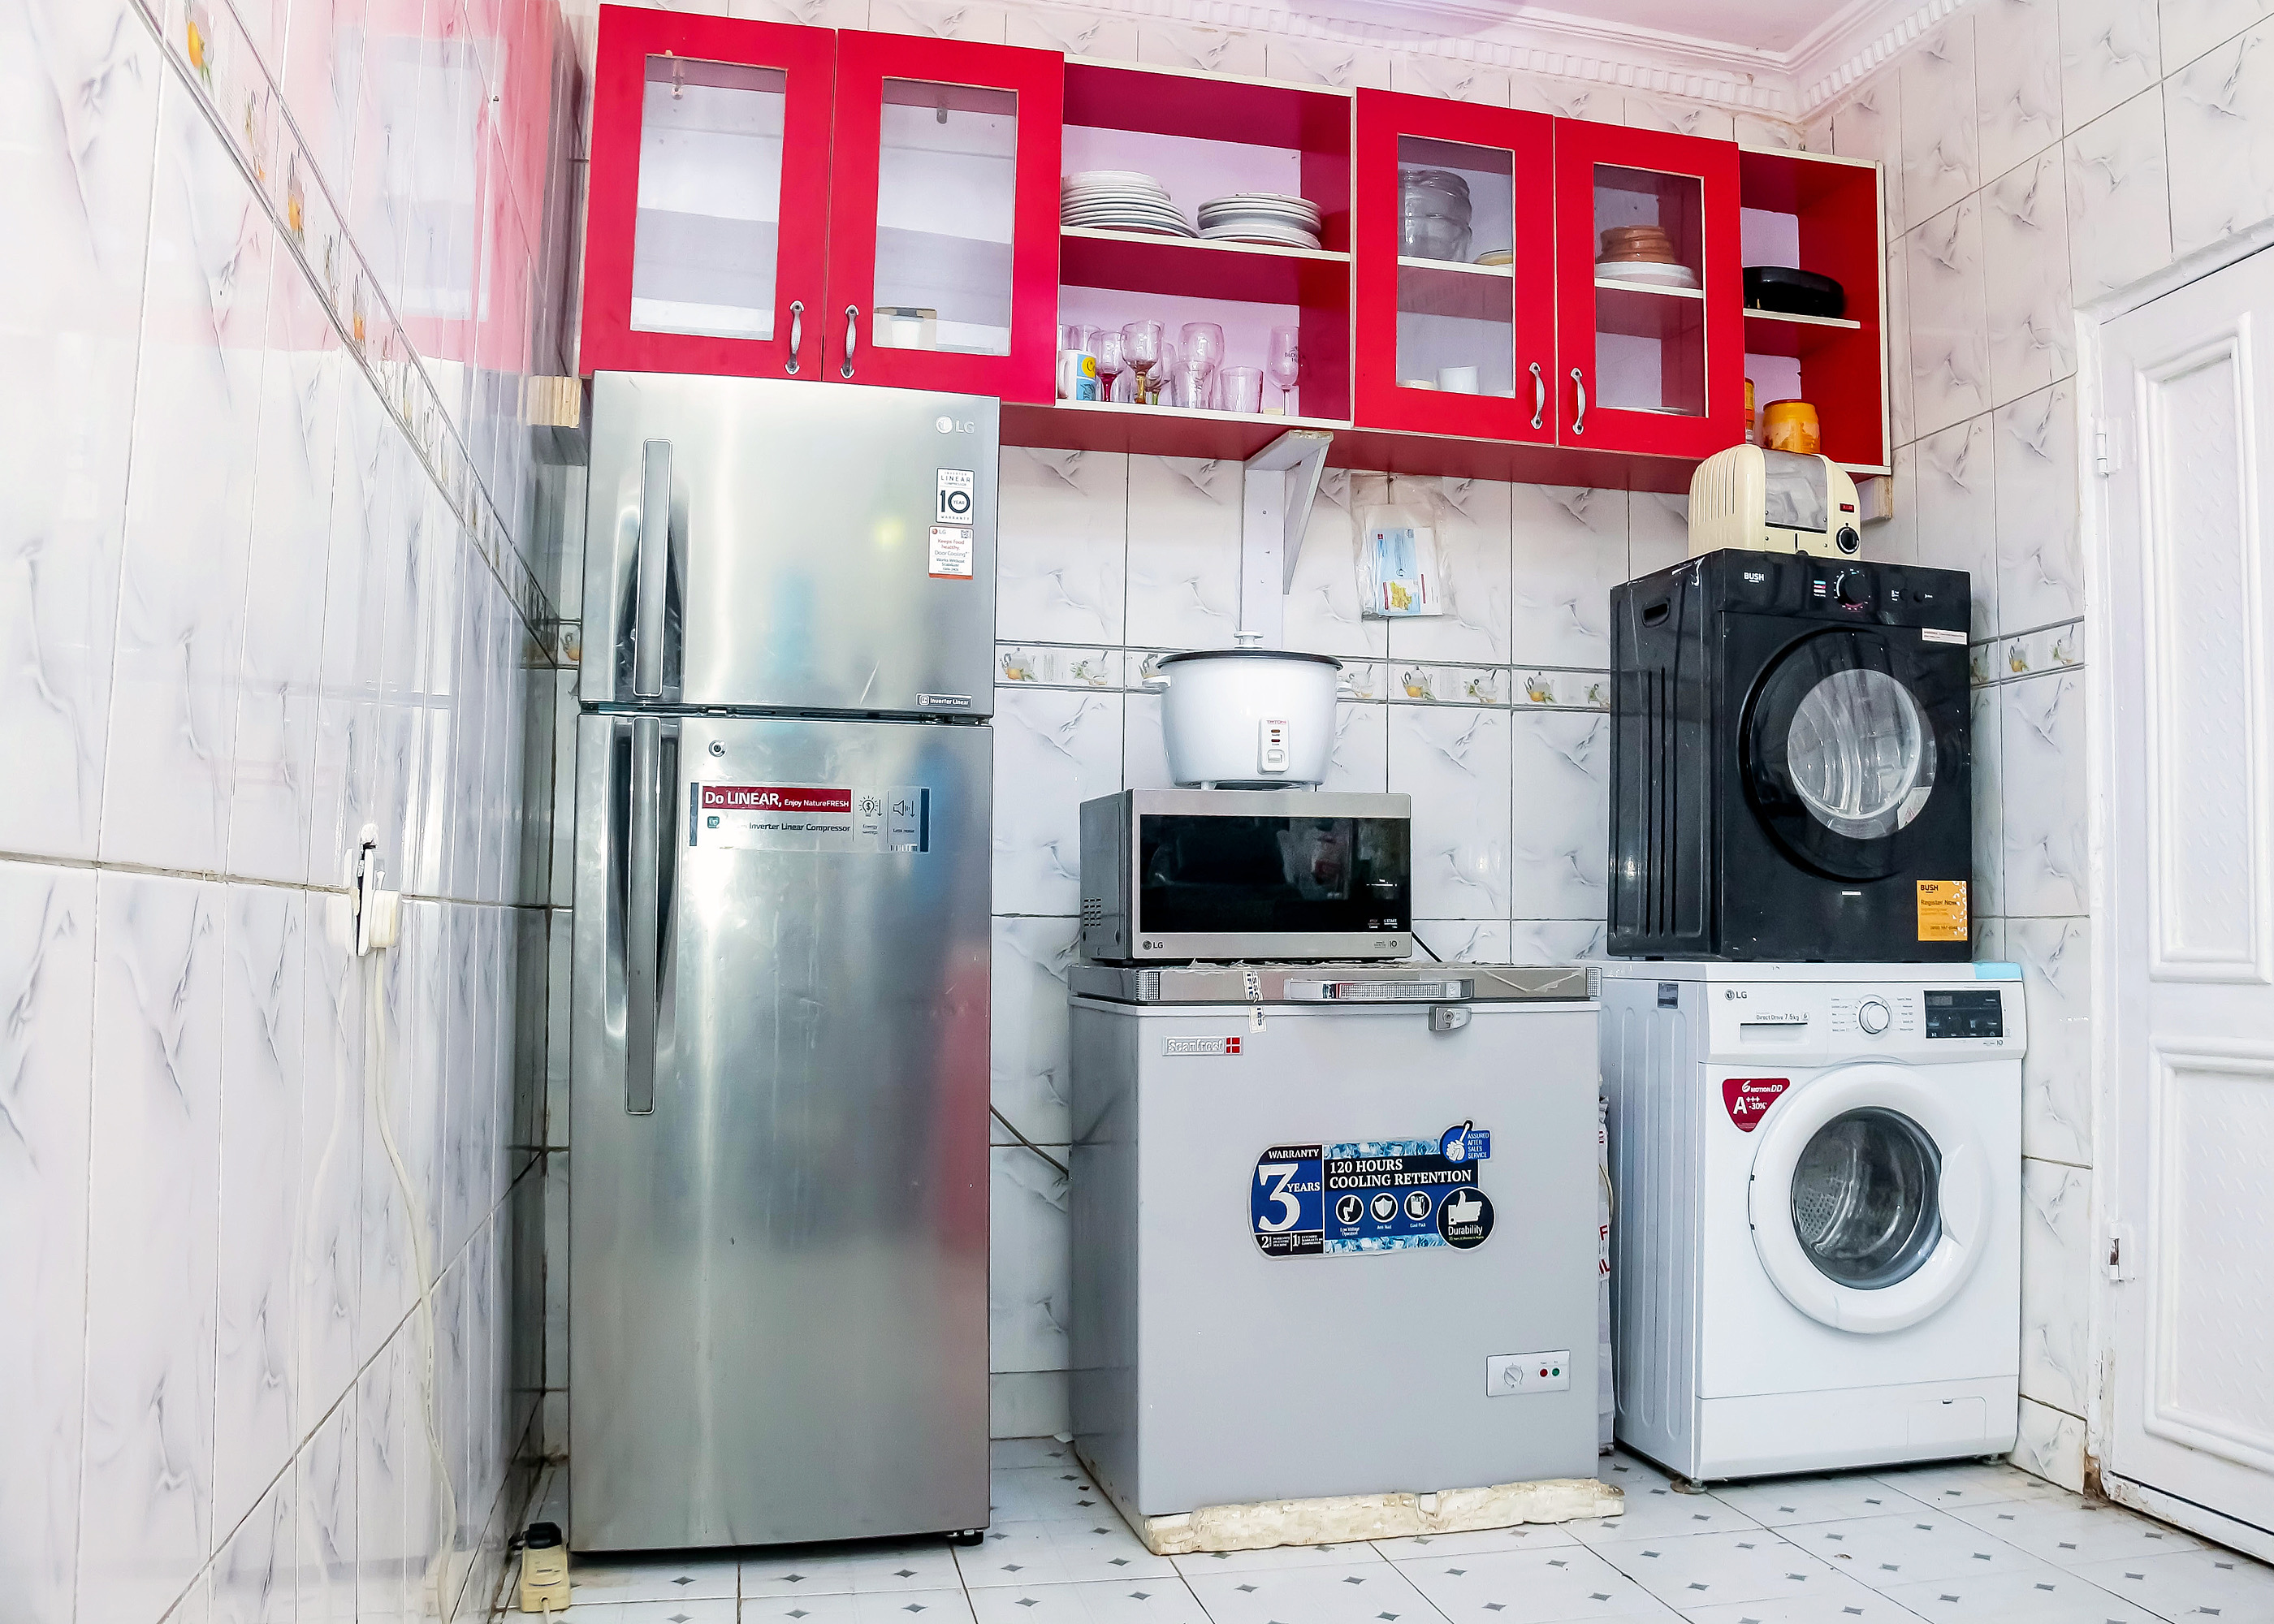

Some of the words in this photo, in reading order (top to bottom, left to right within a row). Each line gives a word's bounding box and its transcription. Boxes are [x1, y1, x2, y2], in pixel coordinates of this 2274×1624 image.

[955, 419, 975, 434] LG
[940, 475, 971, 483] LINEAR
[940, 490, 971, 514] 10
[1744, 572, 1765, 581] BUSH
[705, 791, 724, 805] Do
[727, 792, 782, 808] LINEAR,
[784, 799, 802, 808] Enjoy
[749, 822, 780, 830] Inverter
[781, 823, 804, 831] Linear
[806, 823, 851, 832] Compressor
[1921, 899, 1943, 907] Register
[1152, 941, 1164, 949] LG
[1736, 991, 1748, 999] LG
[1167, 1039, 1224, 1053] Scanfrost
[1268, 1148, 1320, 1160] WARRANTY
[1329, 1161, 1353, 1174] 120
[1355, 1158, 1403, 1173] HOURS
[1329, 1174, 1391, 1189] COOLING
[1394, 1169, 1472, 1186] RETENTION
[1258, 1163, 1301, 1233] 3
[1286, 1182, 1321, 1192] YEARS
[1448, 1224, 1483, 1236] Durability
[1261, 1235, 1269, 1249] 2
[1293, 1233, 1299, 1247] 1
